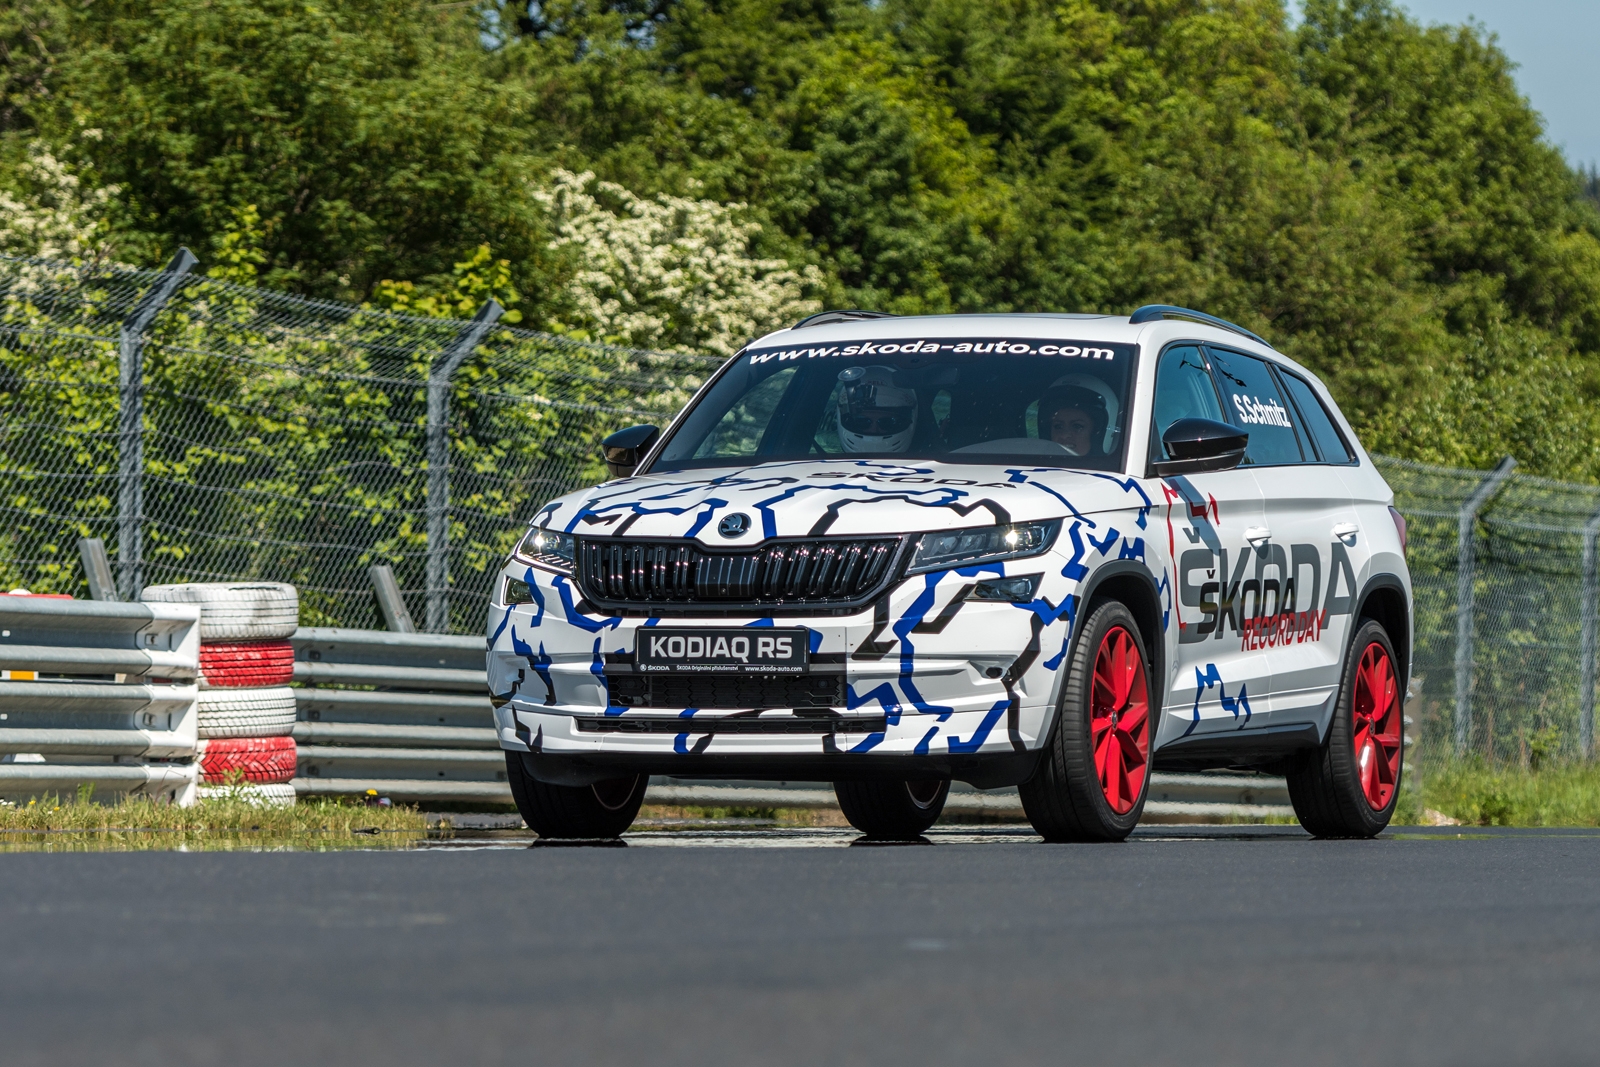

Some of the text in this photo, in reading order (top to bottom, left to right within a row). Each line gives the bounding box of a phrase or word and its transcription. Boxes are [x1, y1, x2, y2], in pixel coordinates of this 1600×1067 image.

[749, 341, 1115, 365] www.skoda-auto.com
[1232, 393, 1292, 428] S.Schmitz
[1178, 527, 1359, 645] ŠKODA
[1196, 569, 1297, 640] ŠKODA
[650, 636, 793, 663] KODIAQ RS
[1241, 608, 1327, 652] RECORD DAY
